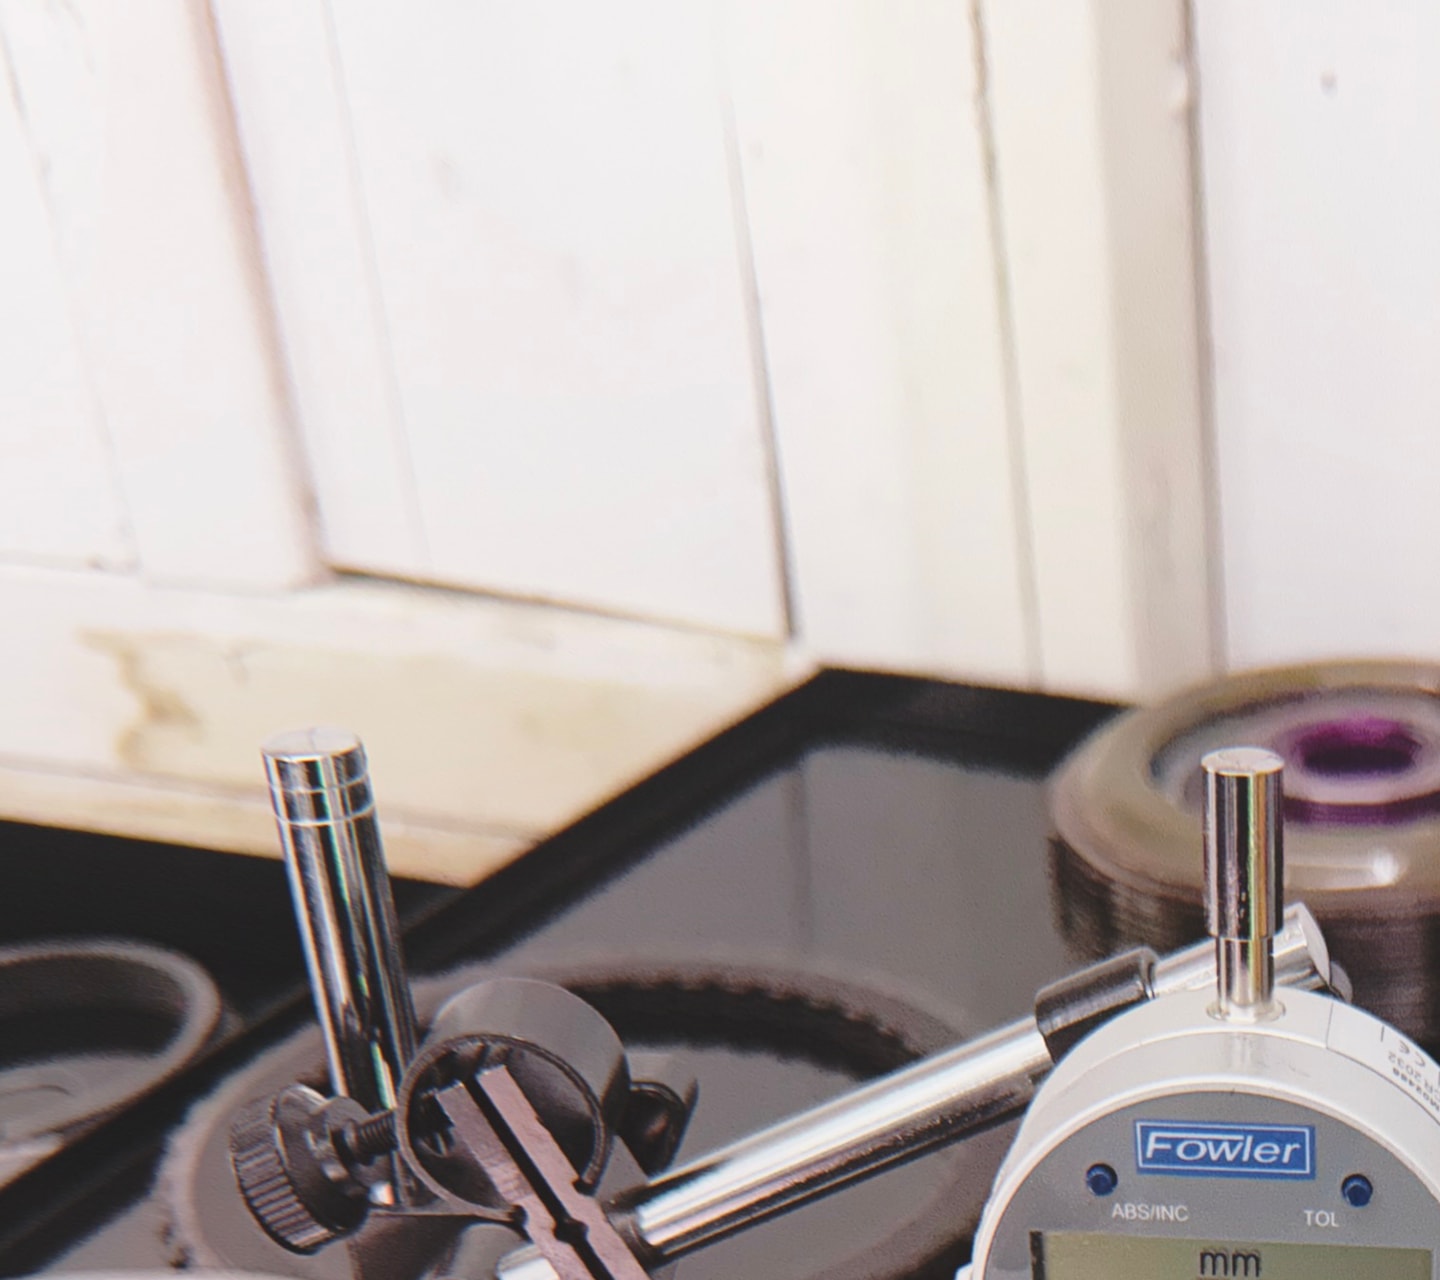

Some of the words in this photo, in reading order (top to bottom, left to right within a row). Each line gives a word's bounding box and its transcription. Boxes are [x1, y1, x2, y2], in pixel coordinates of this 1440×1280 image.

[1388, 1051, 1422, 1080] 2032
[1145, 1131, 1301, 1165] Fowler
[1111, 1203, 1189, 1223] ABS/INC
[1303, 1209, 1340, 1229] TOL
[1199, 1248, 1262, 1278] mm
